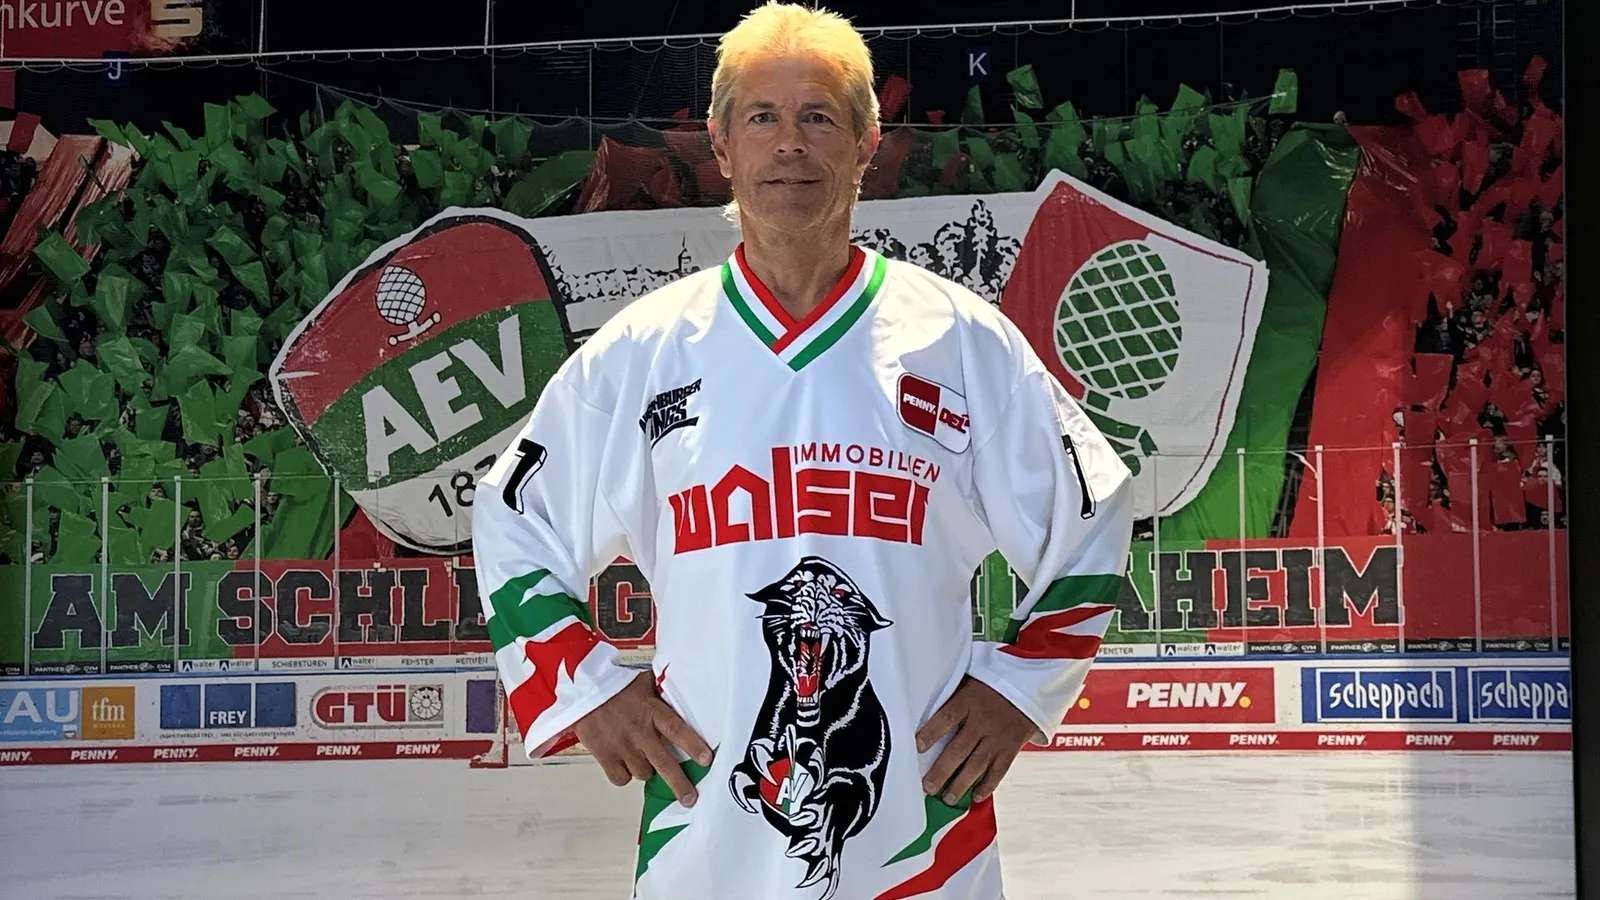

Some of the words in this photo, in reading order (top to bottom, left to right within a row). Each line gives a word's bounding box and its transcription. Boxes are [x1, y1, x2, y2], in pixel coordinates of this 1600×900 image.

[969, 52, 988, 76] K
[362, 313, 526, 483] AEV
[32, 571, 192, 650] AM
[401, 658, 435, 666] FENSTER
[1099, 647, 1133, 655] FENSTER
[316, 685, 406, 723] GTÜ
[1329, 670, 1444, 720] scheppach
[91, 697, 125, 721] tfm
[209, 710, 247, 725] FREY
